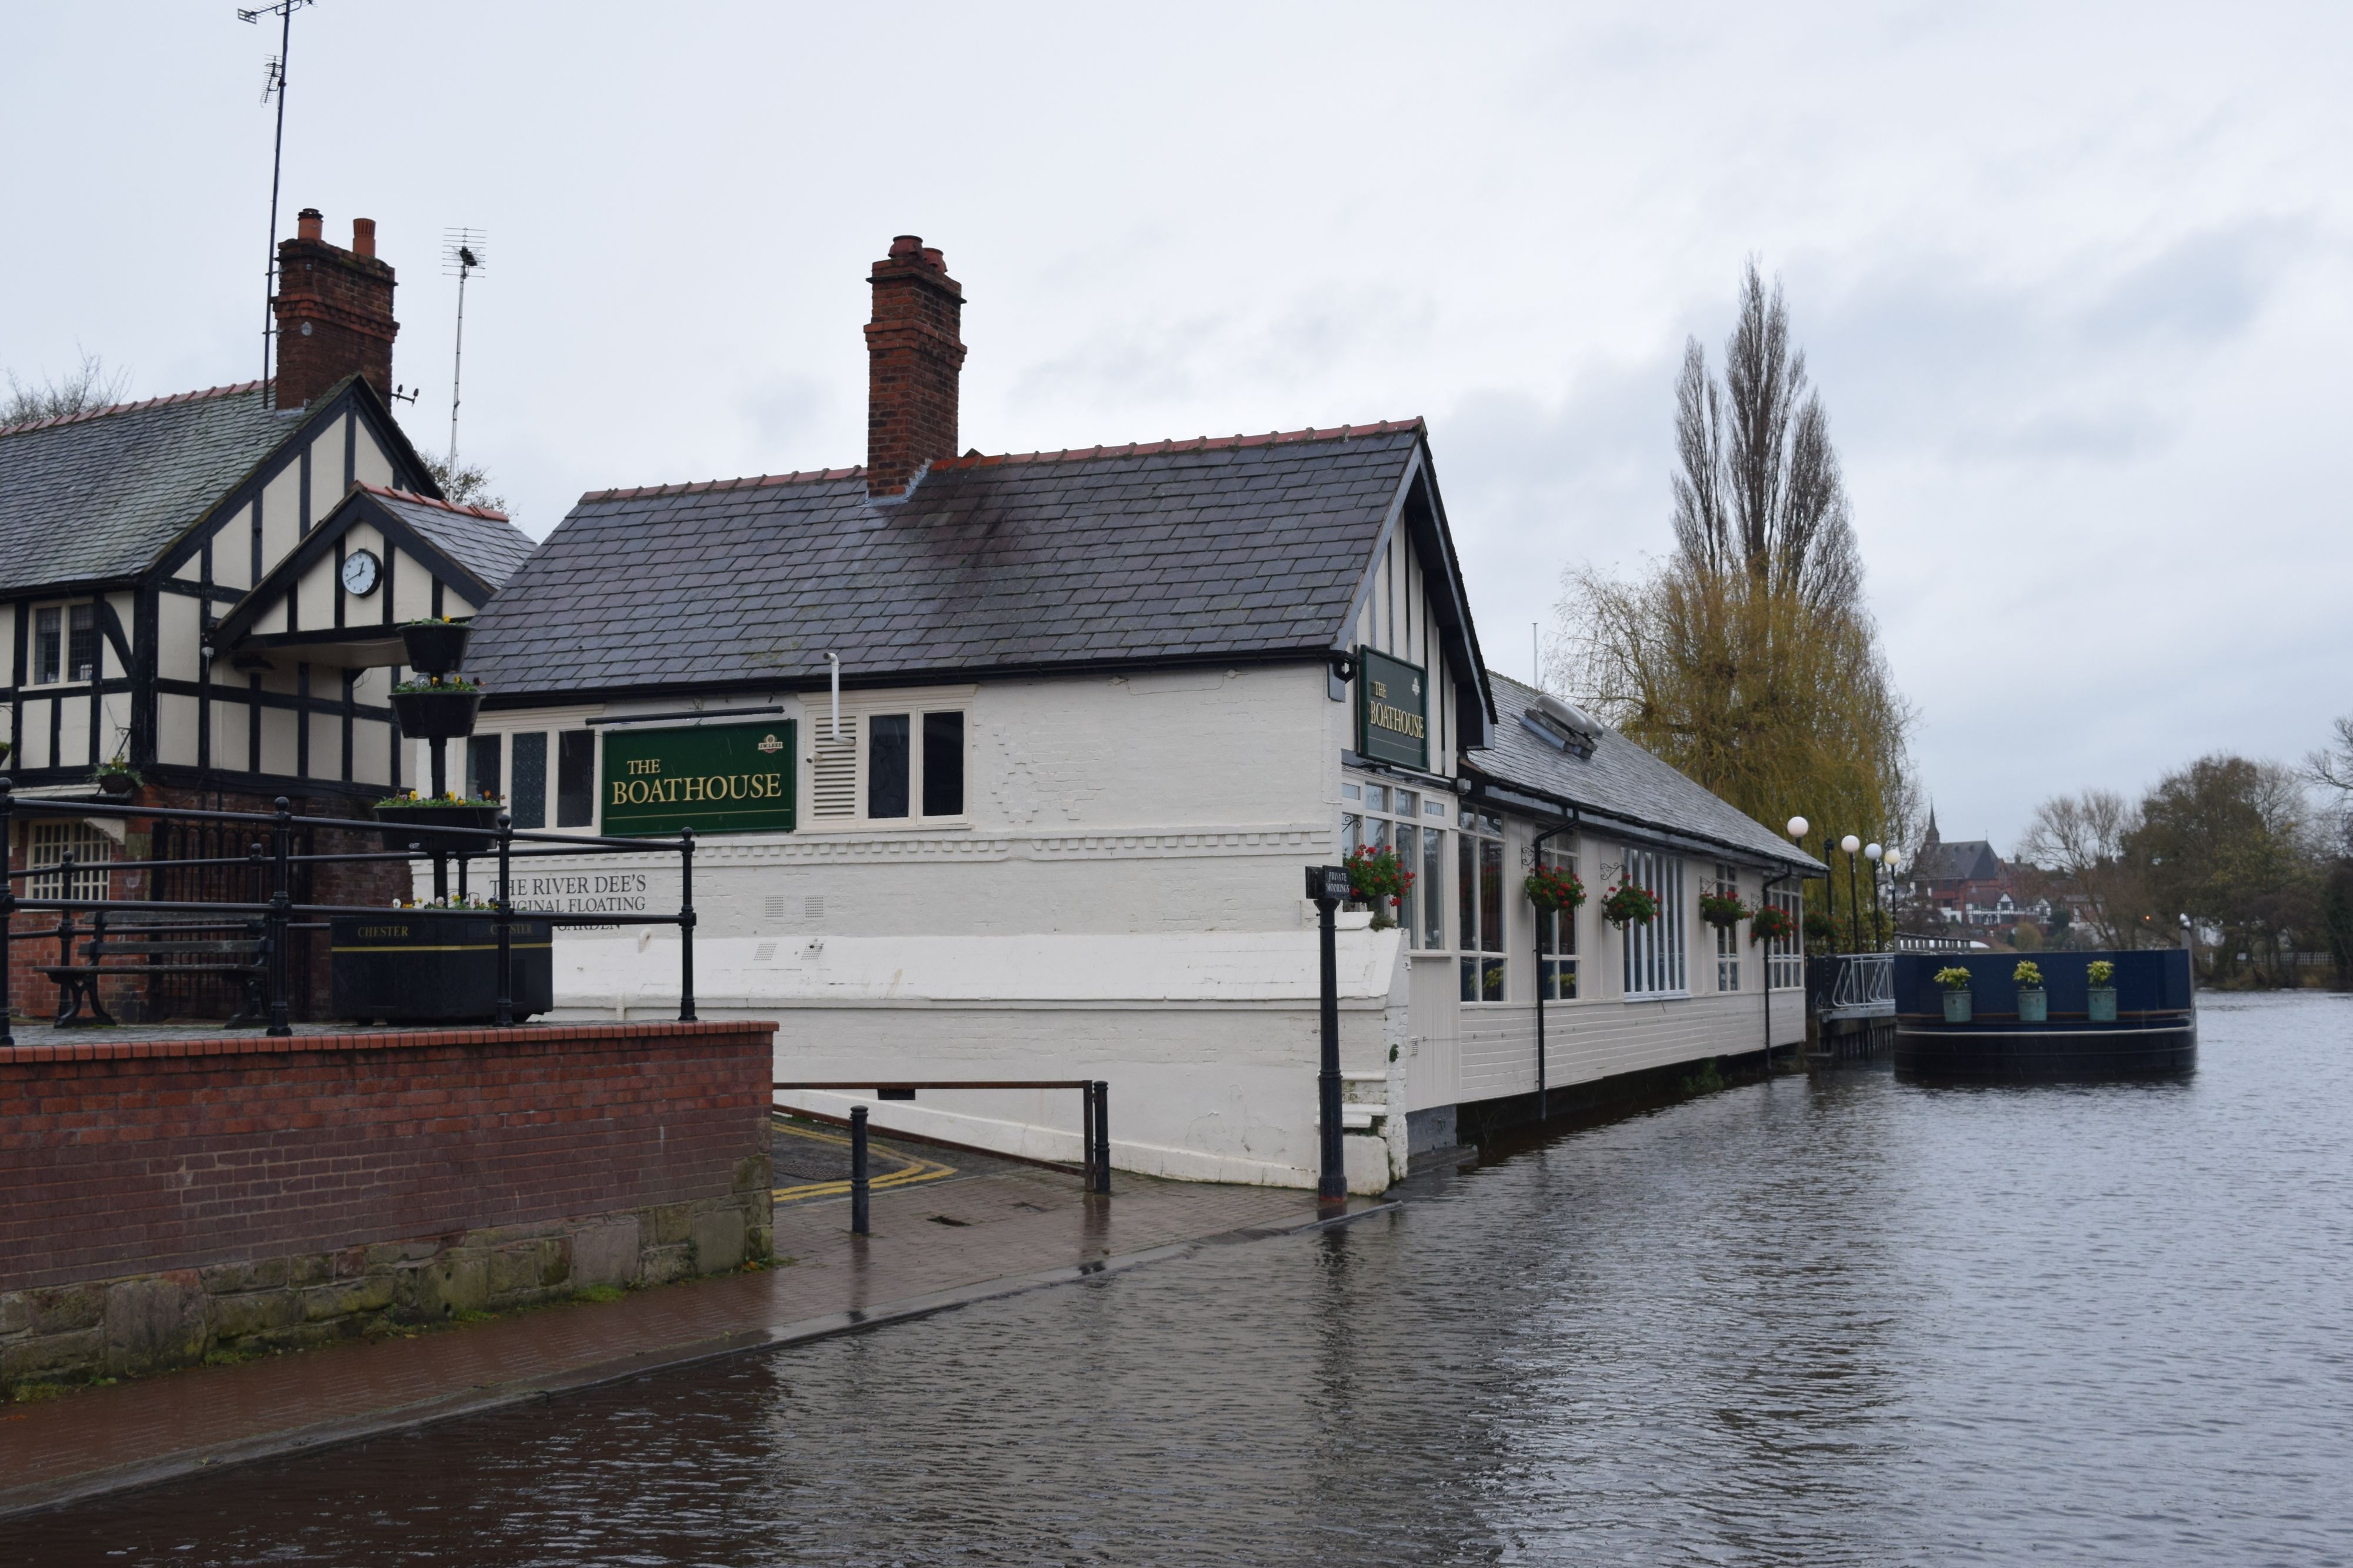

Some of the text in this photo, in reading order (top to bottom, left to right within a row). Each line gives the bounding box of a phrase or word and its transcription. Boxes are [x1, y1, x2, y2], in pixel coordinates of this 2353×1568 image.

[1374, 681, 1387, 698] THE
[1370, 700, 1424, 739] BOATHOUSE
[627, 759, 661, 775] THE
[612, 773, 782, 805] BOATHOUSE
[1328, 871, 1347, 881] PRIVATE
[532, 877, 589, 895] RIVER
[594, 874, 646, 893] DEE'S
[1325, 883, 1349, 893] MOORINGS
[568, 896, 646, 912] FLOATING
[358, 925, 409, 938] CHESTER
[489, 923, 532, 935] CSTER
